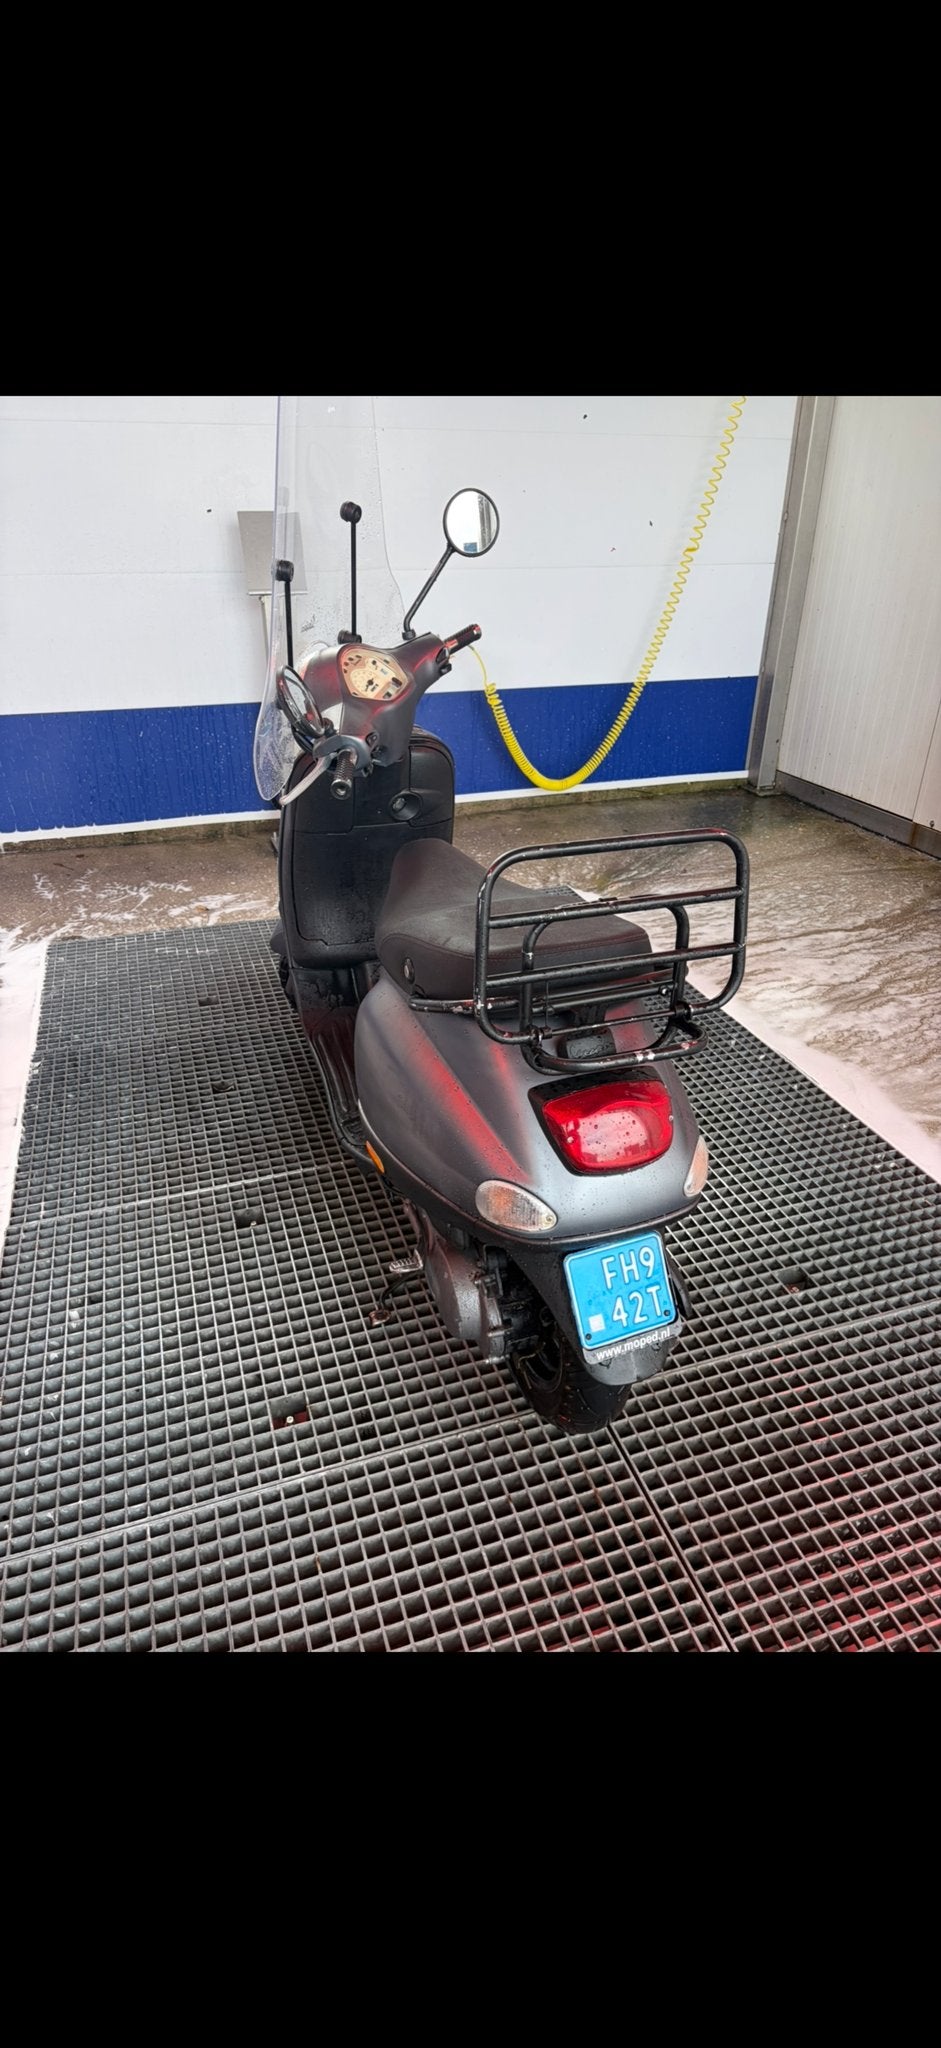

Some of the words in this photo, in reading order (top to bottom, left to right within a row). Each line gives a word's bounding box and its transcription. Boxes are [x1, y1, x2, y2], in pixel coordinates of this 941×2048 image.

[601, 1246, 655, 1290] FH9
[612, 1285, 661, 1328] 42T
[596, 1327, 671, 1361] www.moped.nl
